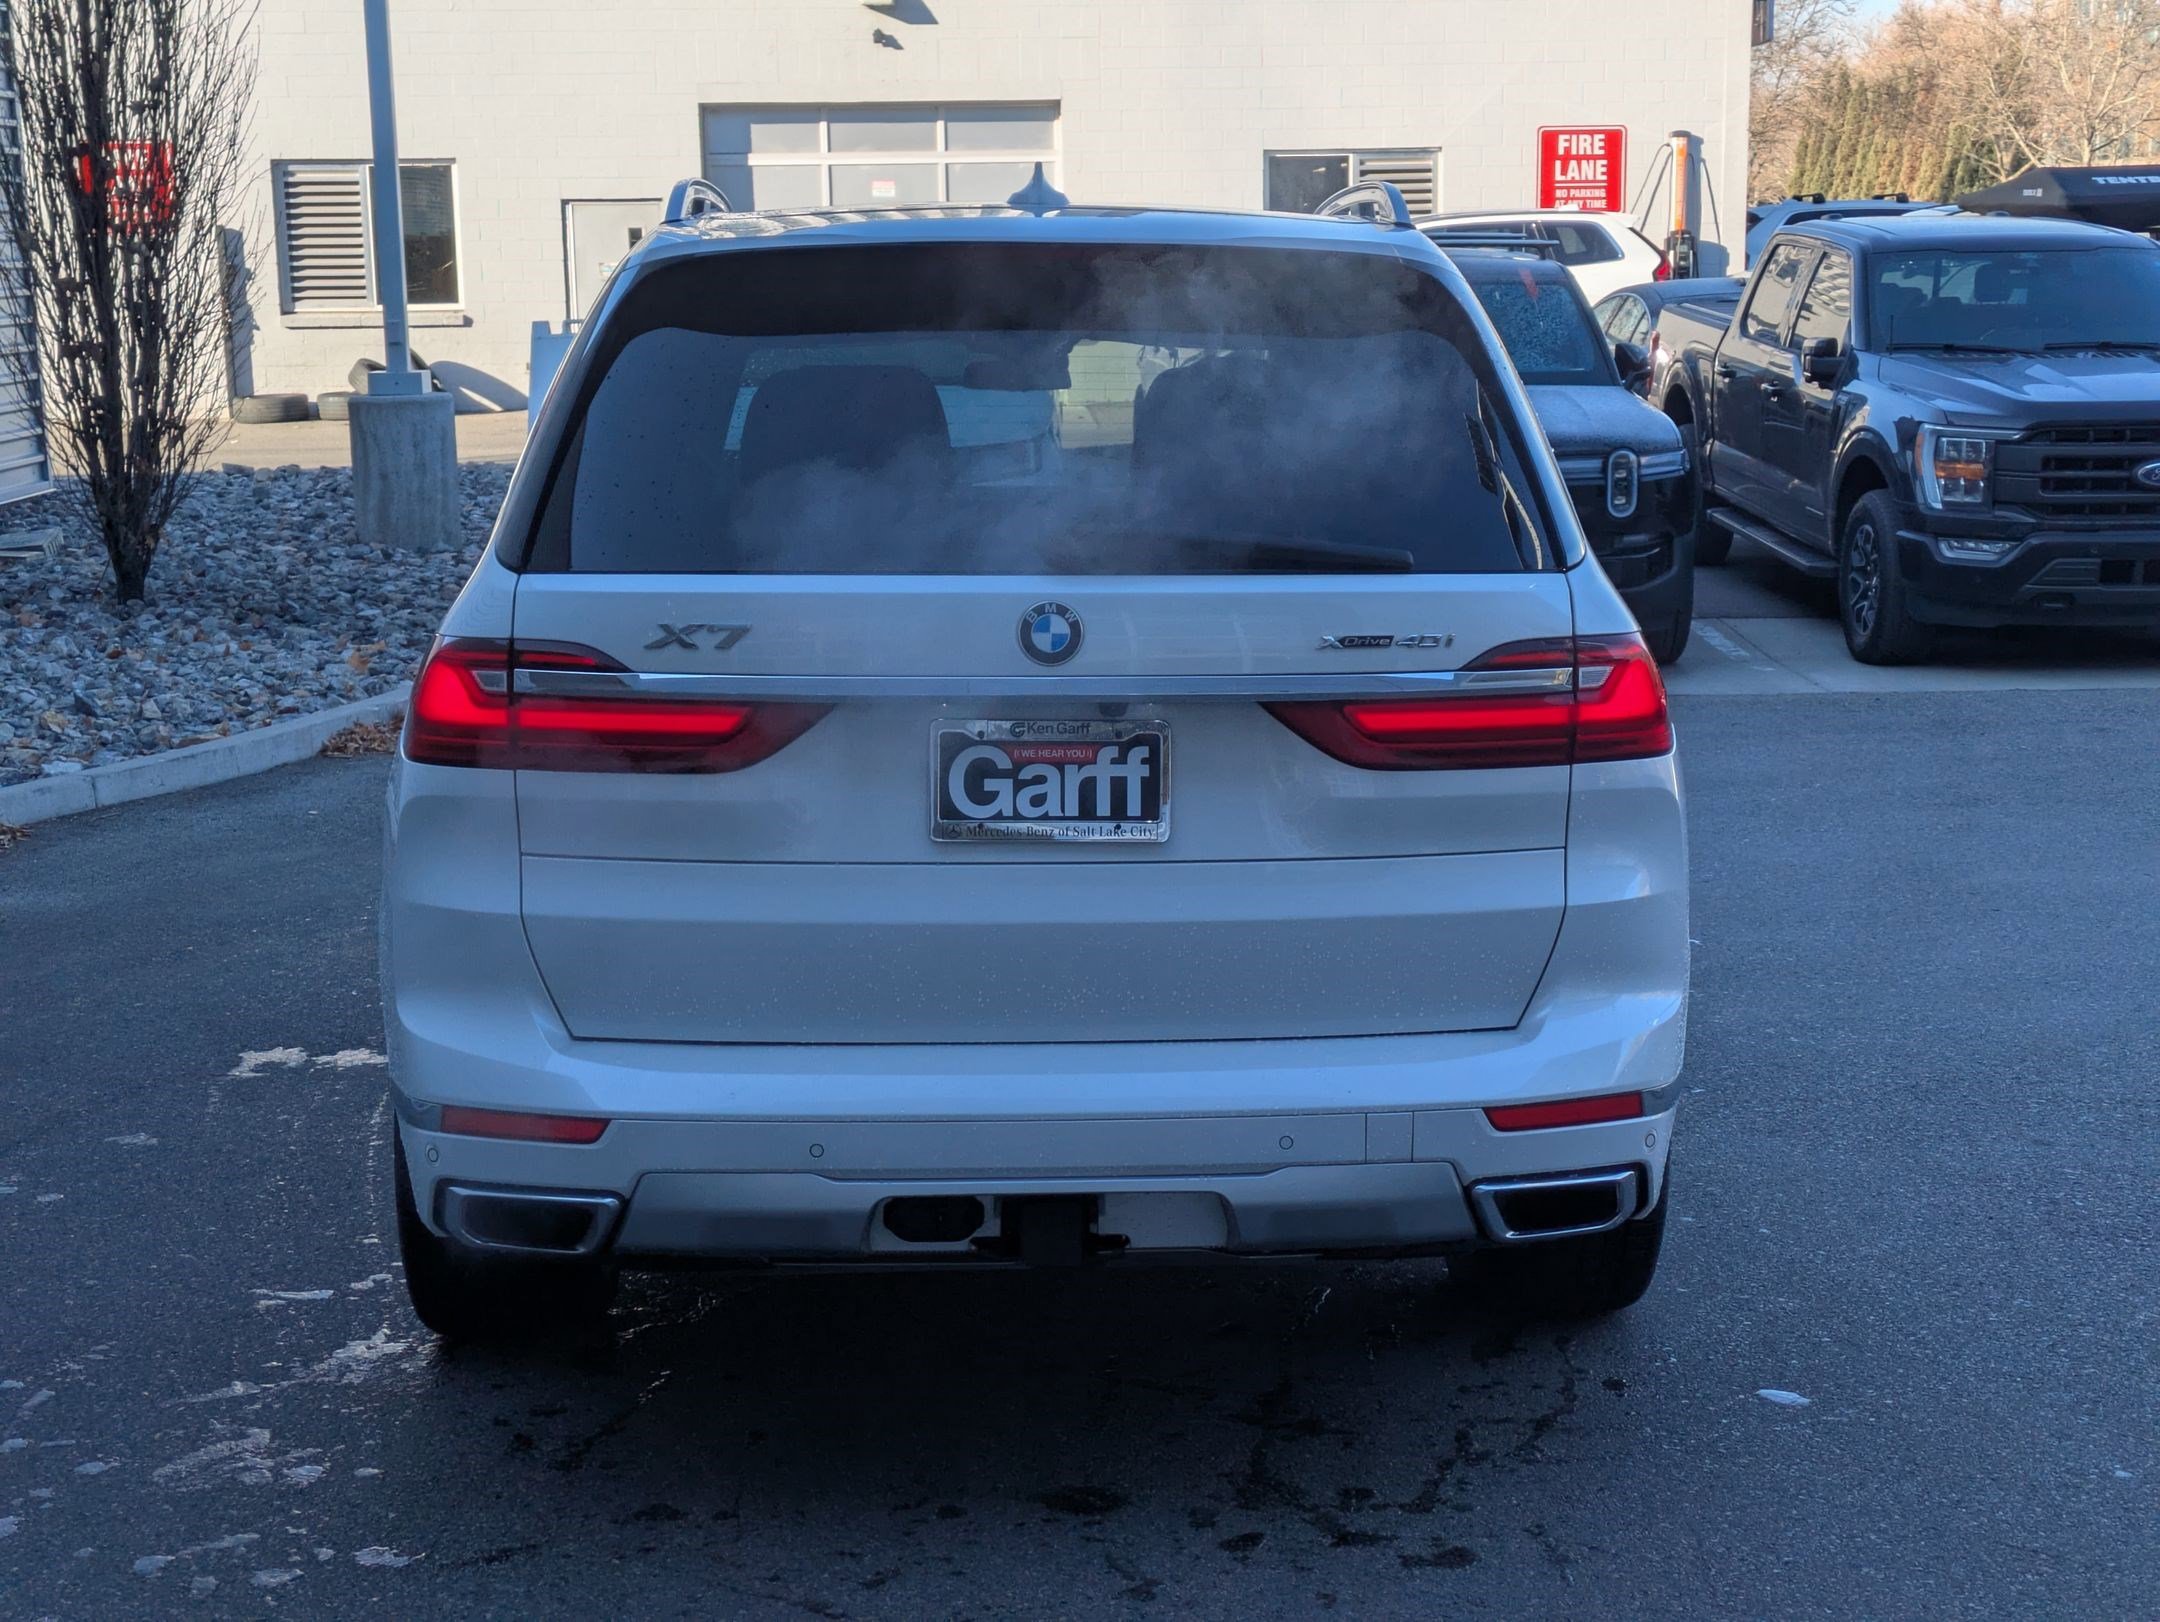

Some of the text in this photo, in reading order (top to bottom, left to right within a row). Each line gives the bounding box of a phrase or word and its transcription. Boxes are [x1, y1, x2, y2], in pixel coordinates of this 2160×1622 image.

[1557, 134, 1605, 155] FIRE
[1554, 159, 1608, 181] LANE
[1555, 188, 1606, 198] NO PARKING
[1585, 199, 1607, 209] TIME
[1026, 603, 1077, 623] BMW
[643, 623, 752, 650] X7
[1027, 722, 1092, 735] Ken Garff
[1020, 749, 1086, 758] WE HEAR YOU
[948, 744, 1150, 819] Garff
[1058, 825, 1071, 837] of
[1073, 825, 1095, 837] Salt
[1099, 825, 1127, 838] Lake
[1130, 825, 1155, 839] City
